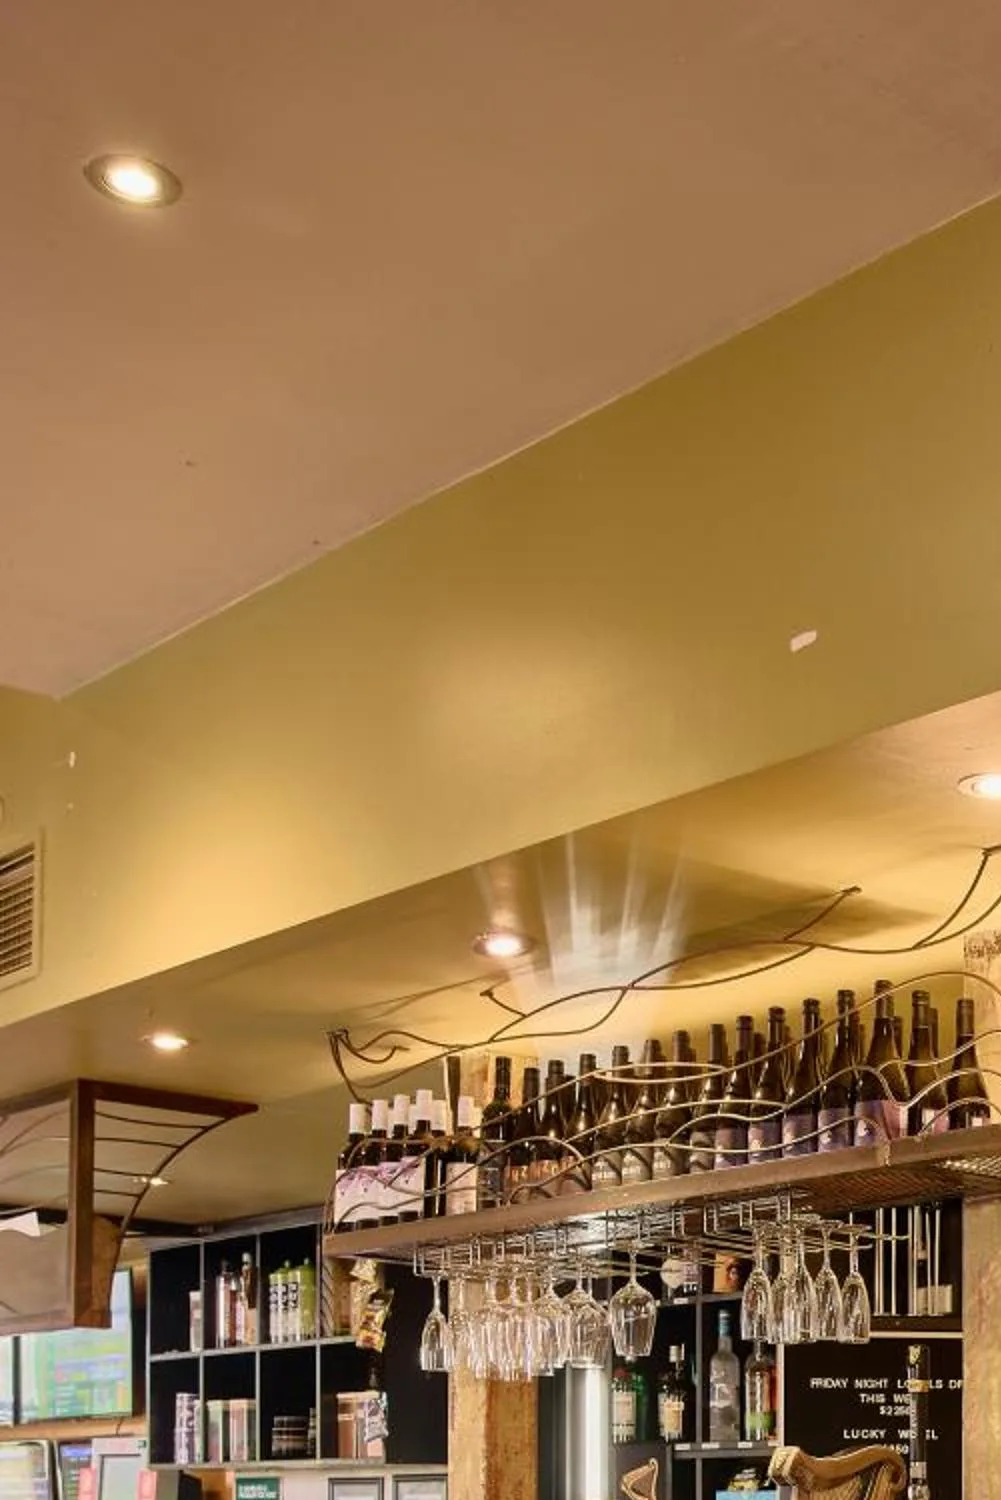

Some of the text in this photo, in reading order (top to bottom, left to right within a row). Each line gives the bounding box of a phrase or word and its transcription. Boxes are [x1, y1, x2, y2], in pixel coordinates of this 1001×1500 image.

[809, 1377, 849, 1390] FRIDAY
[854, 1378, 889, 1390] NIGHT
[859, 1393, 886, 1405] THIS
[843, 1428, 887, 1440] LUCKY
